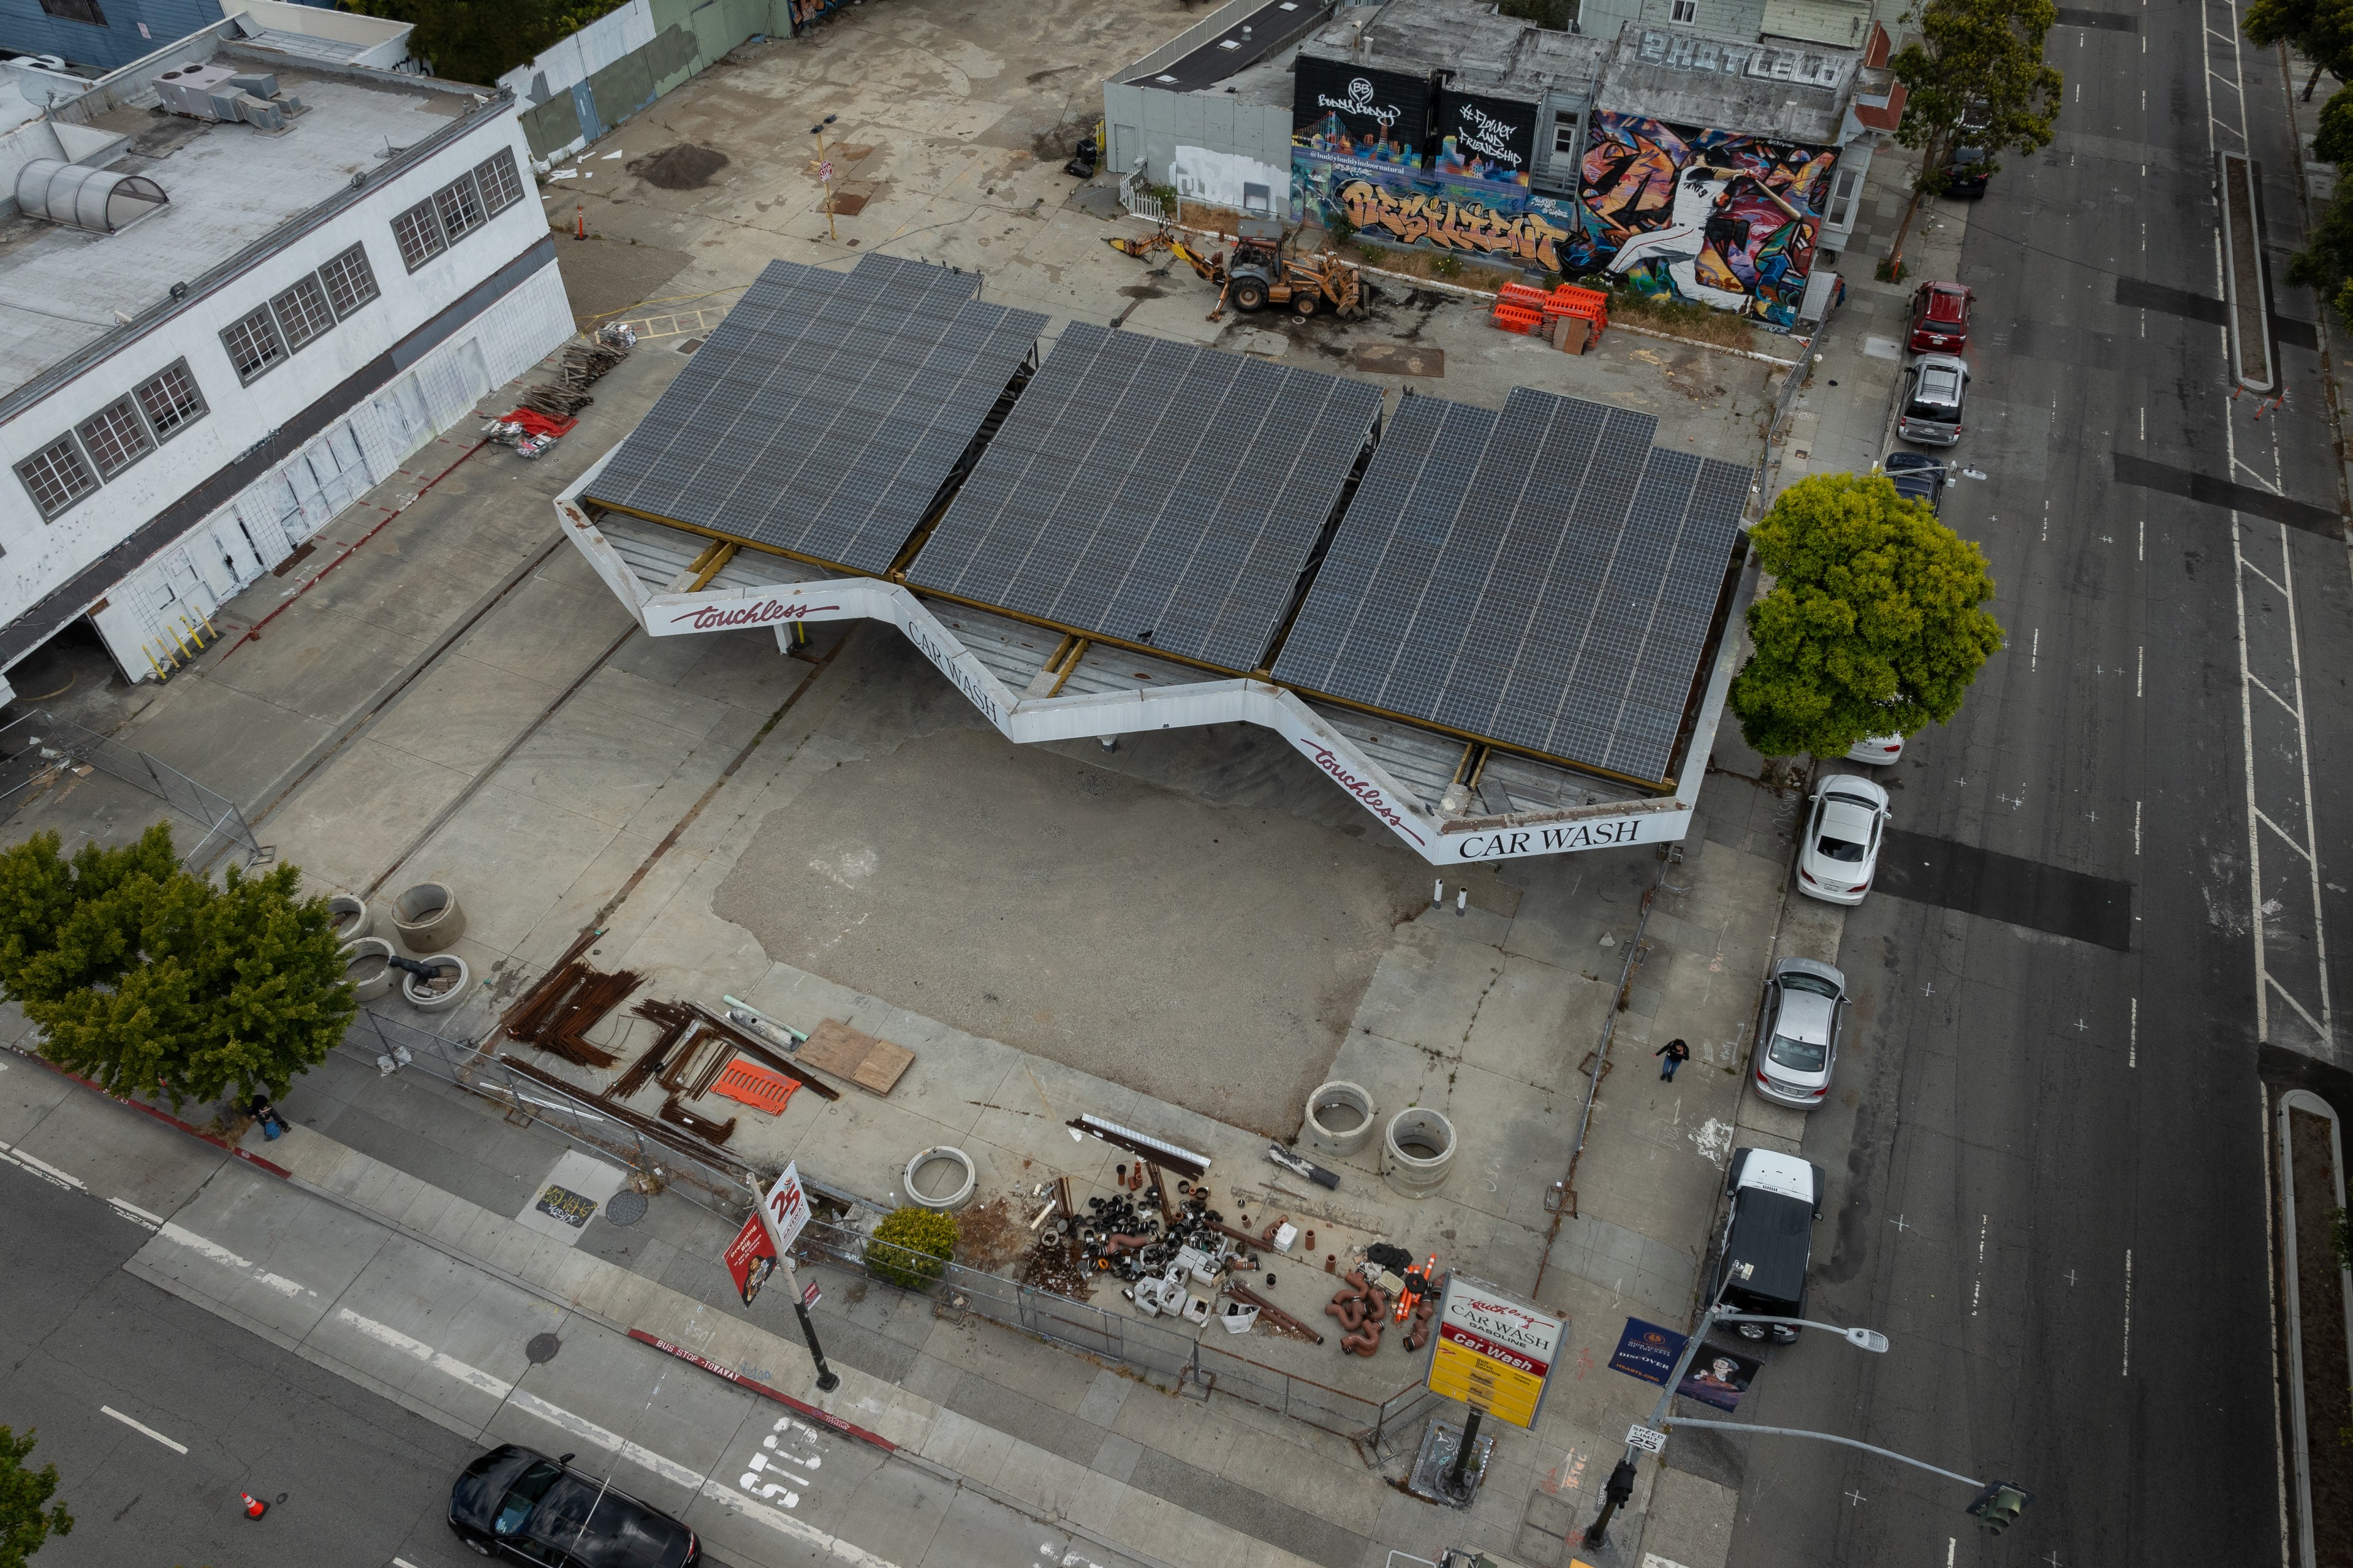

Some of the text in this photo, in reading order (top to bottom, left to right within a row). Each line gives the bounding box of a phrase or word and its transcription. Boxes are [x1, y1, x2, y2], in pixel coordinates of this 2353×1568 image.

[1458, 127, 1522, 167] FRIENDSHIP
[1476, 129, 1504, 147] AND
[820, 165, 832, 178] STOP
[1310, 151, 1404, 174] @buddybuddyindoornatural
[671, 600, 840, 629] touchless
[908, 621, 1000, 726] CAR WASH
[1306, 742, 1422, 843] touchless
[1458, 819, 1642, 859] CAR WASH
[770, 1183, 800, 1224] 25
[783, 1201, 804, 1240] GATEWAY
[730, 1224, 757, 1258] Dreaming
[741, 1240, 751, 1252] Big
[744, 1233, 762, 1254] Francisco
[749, 1241, 760, 1255] Years
[1451, 1305, 1550, 1350] CAR WASH
[1469, 1322, 1528, 1349] GASOLINE
[656, 1339, 675, 1353] BUS
[676, 1348, 699, 1362] STOP
[1453, 1333, 1533, 1371] Car Wash
[1647, 1344, 1672, 1355] SCHOOL
[1475, 1365, 1501, 1377] Gasoline
[1476, 1362, 1494, 1370] Serve
[1619, 1352, 1669, 1371] DISCOVER
[1471, 1373, 1493, 1385] Regular
[1514, 1373, 1532, 1382] Credit
[1616, 1363, 1659, 1382] HSARTS.ORG
[1467, 1398, 1489, 1410] Premium
[1632, 1426, 1664, 1439] SPEED
[1634, 1431, 1659, 1442] LIMIT
[1629, 1436, 1658, 1450] 25
[740, 1417, 828, 1508] STOP
